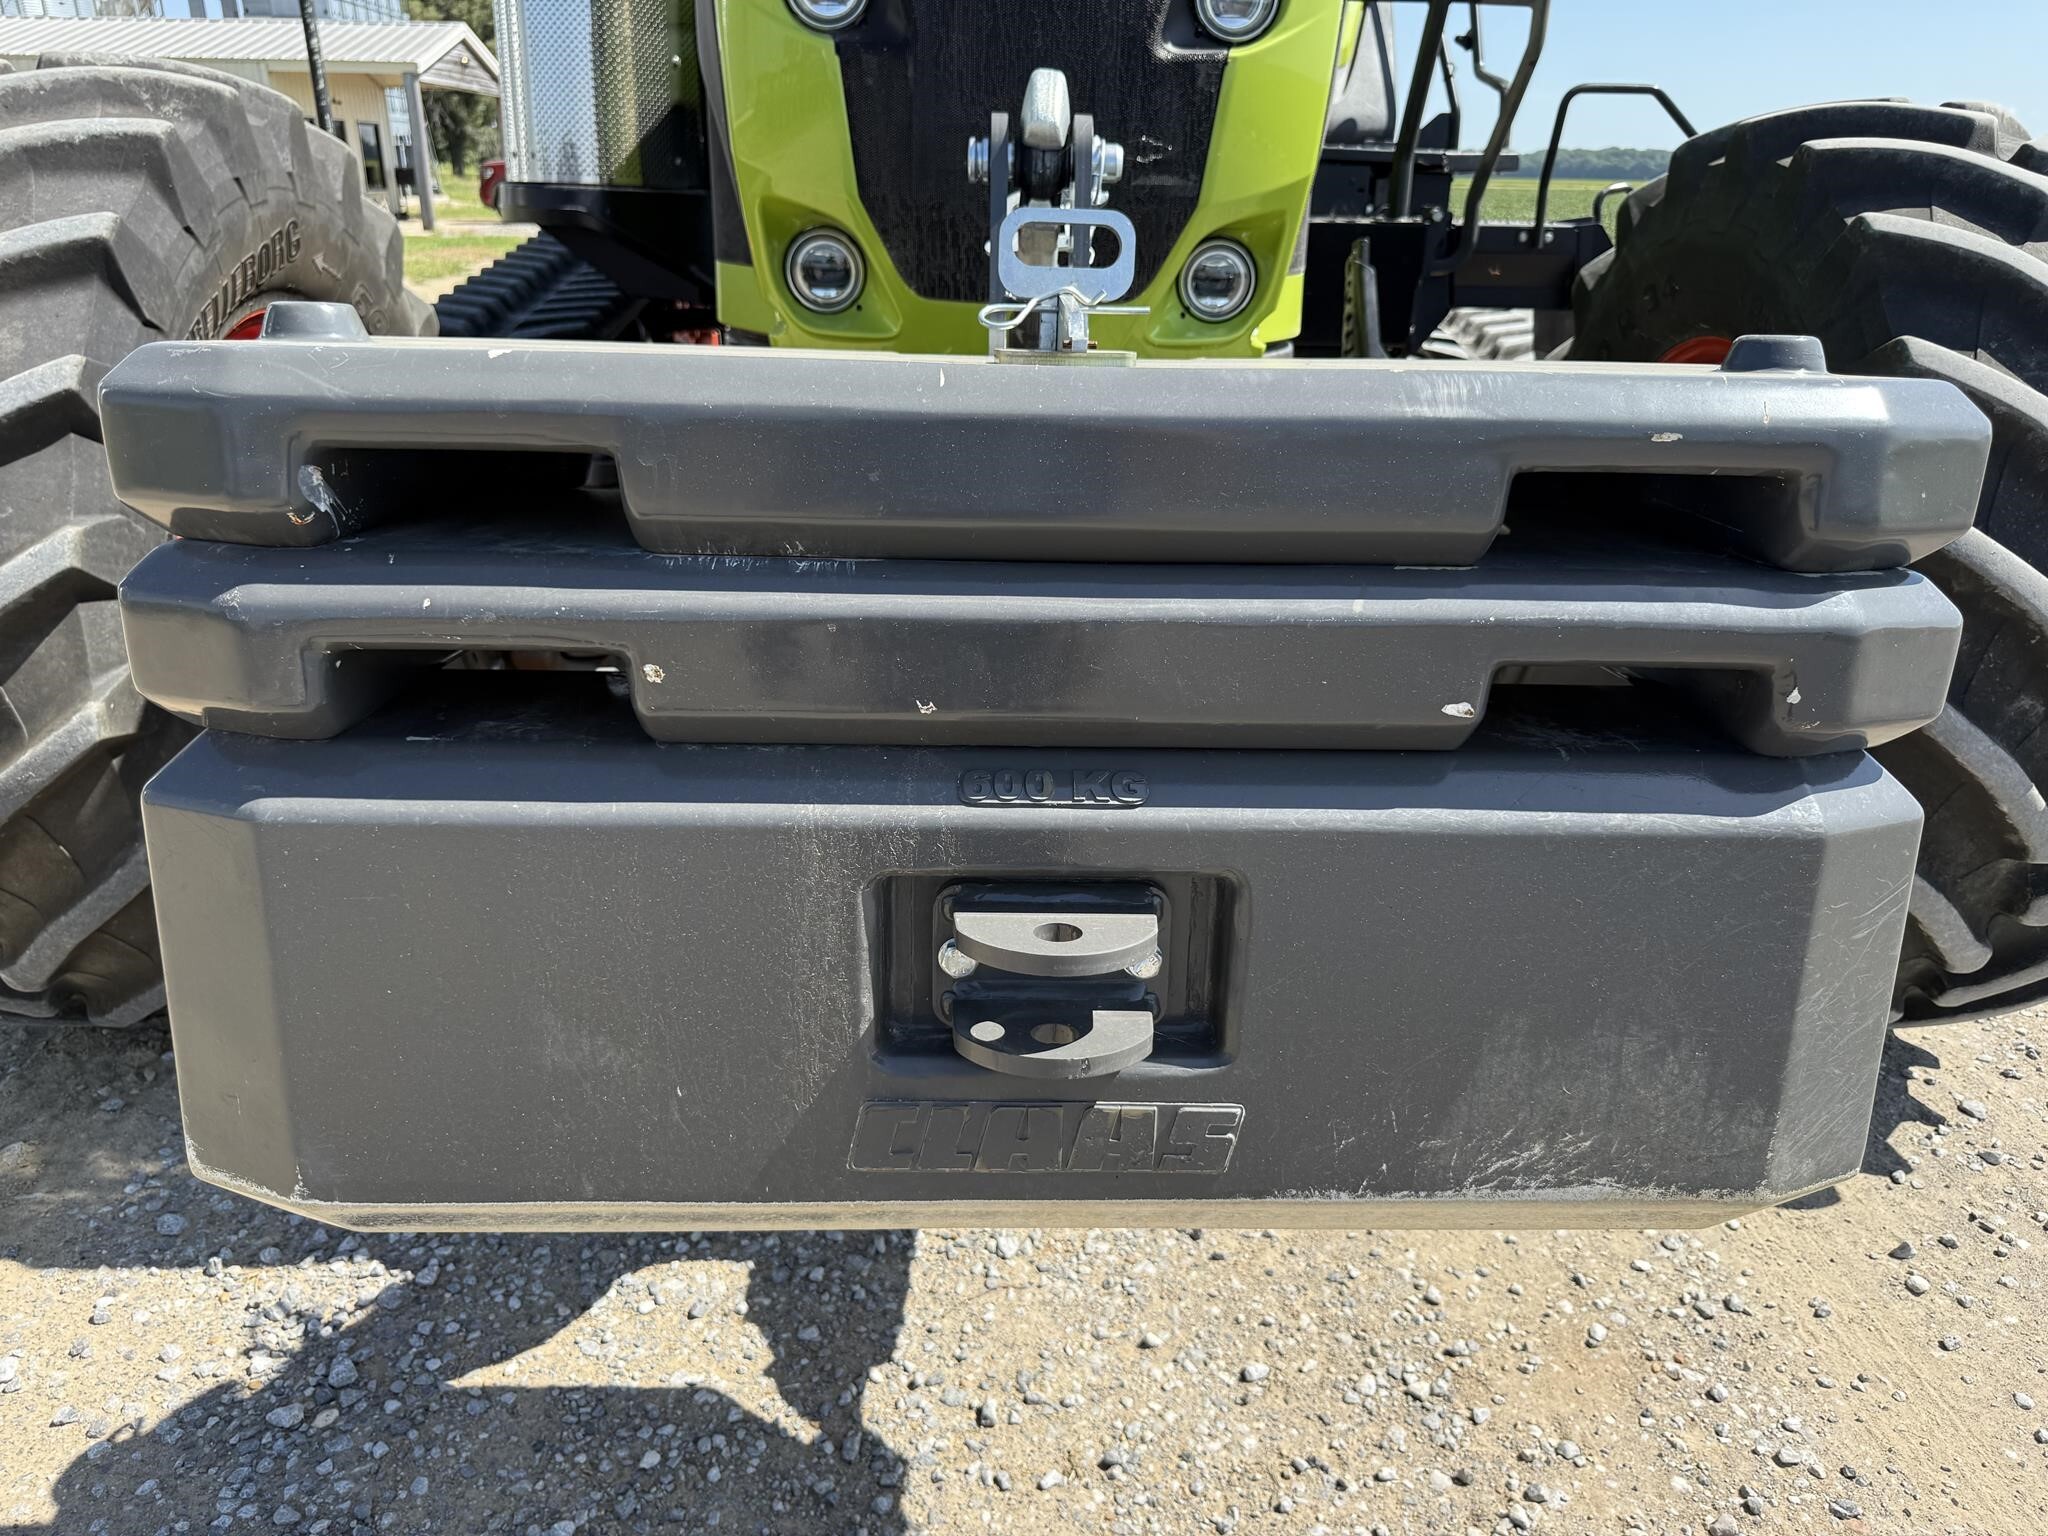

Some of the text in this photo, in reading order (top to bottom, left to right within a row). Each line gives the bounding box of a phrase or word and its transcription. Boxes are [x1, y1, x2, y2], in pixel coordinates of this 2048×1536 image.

[960, 769, 1149, 804] 600 KG
[847, 1101, 1245, 1172] CLAAS
